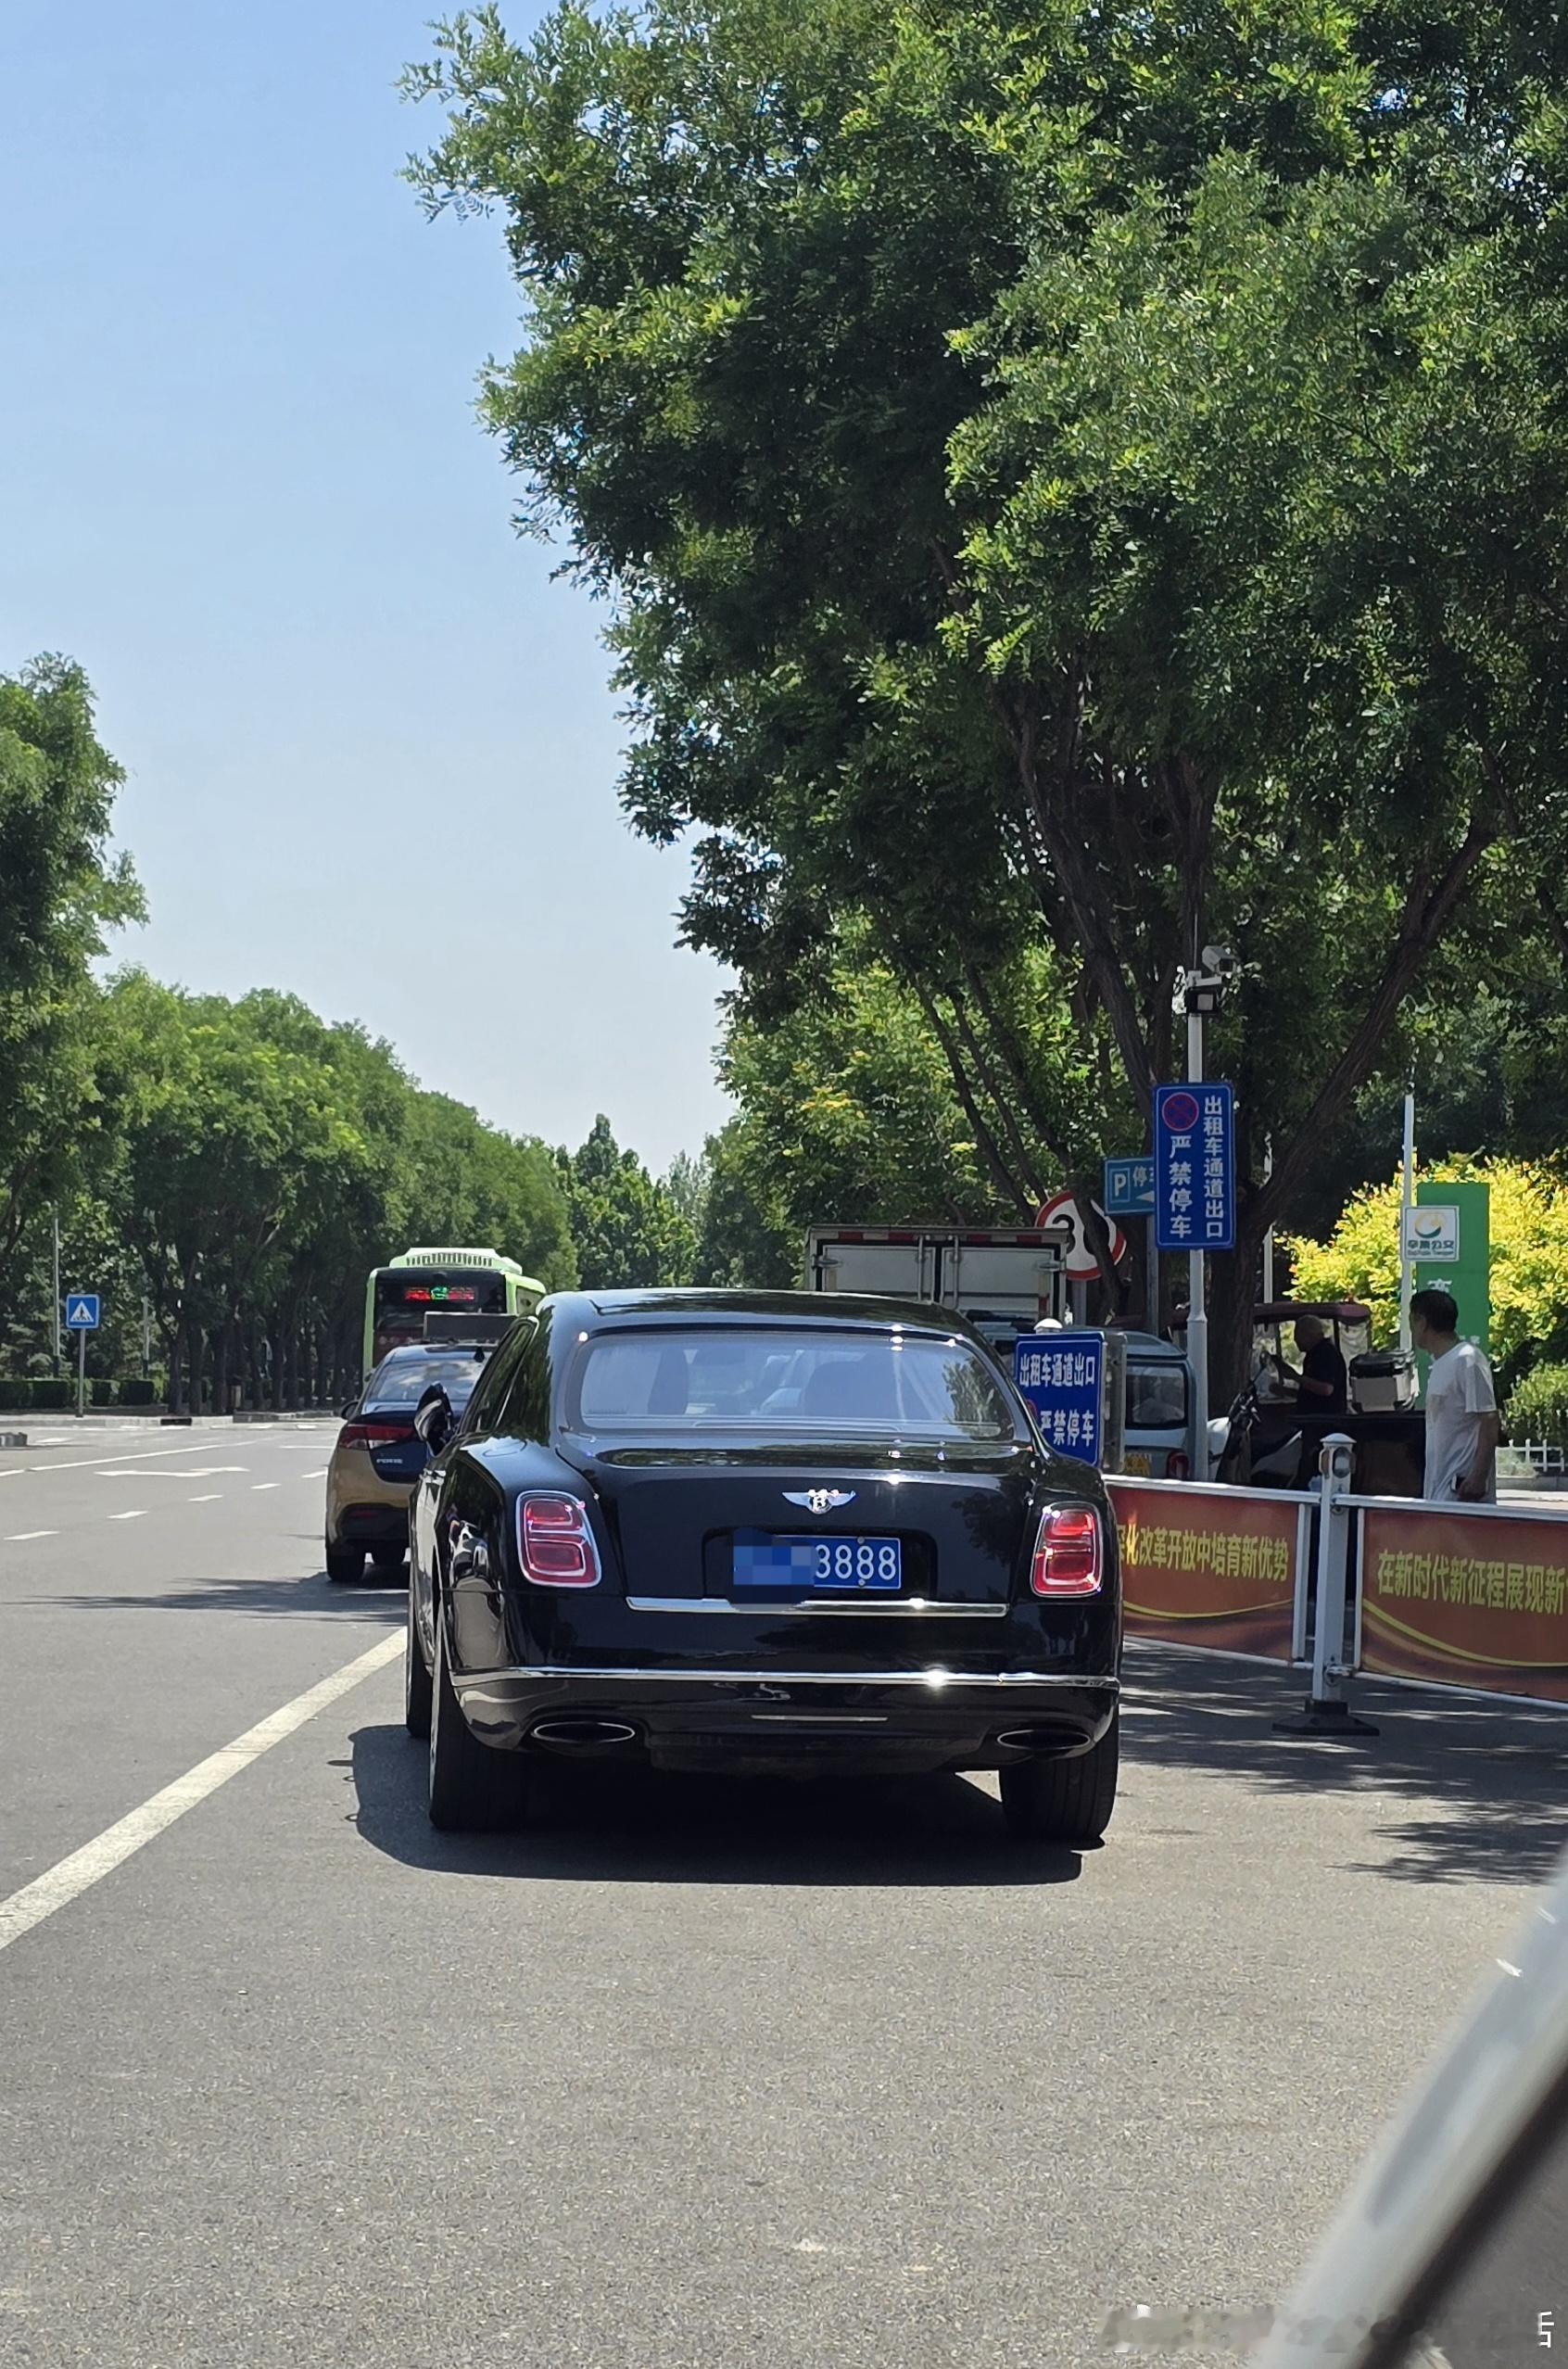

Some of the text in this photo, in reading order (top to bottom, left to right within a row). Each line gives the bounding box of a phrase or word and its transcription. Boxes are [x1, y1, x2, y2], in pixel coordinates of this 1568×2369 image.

[1114, 1165, 1155, 1197] P 停
[1203, 1095, 1224, 1238] 出租车通道出口
[1169, 1135, 1193, 1239] 严禁停车
[1019, 1352, 1095, 1387] 出租车通道出口
[1038, 1409, 1094, 1448] 严禁停车
